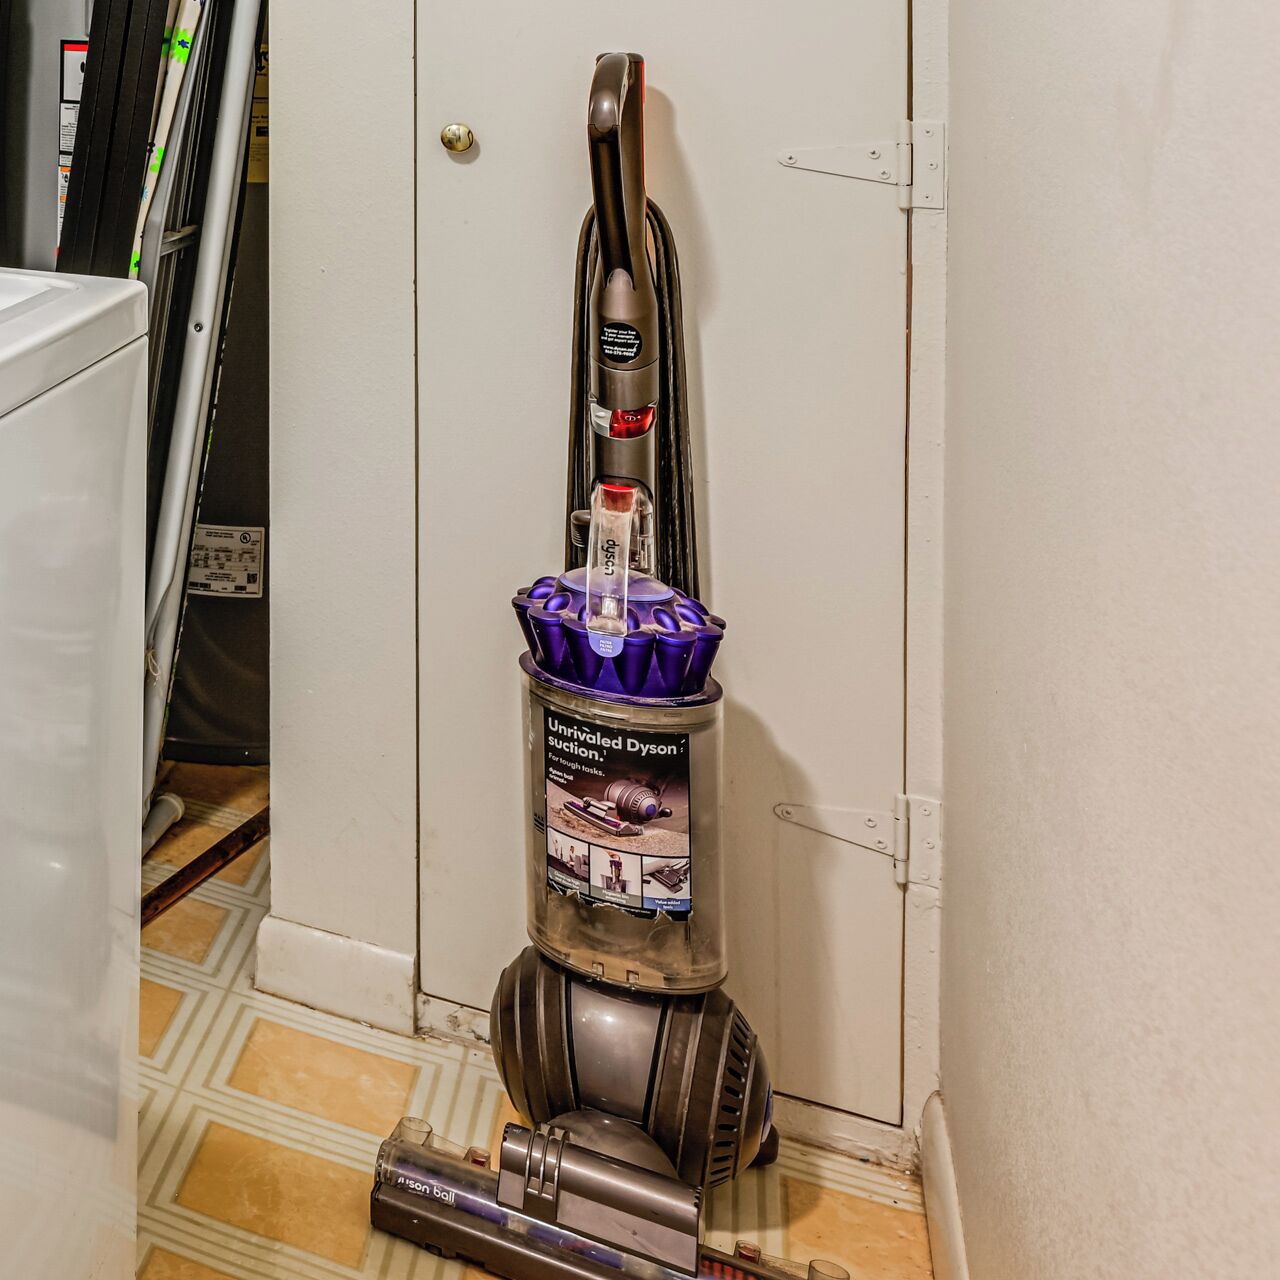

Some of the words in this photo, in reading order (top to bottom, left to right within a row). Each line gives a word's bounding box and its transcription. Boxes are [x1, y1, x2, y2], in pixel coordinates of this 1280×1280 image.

[601, 539, 620, 576] dyson
[548, 717, 622, 750] Unrivaled
[548, 752, 559, 762] For
[560, 756, 581, 770] tough
[582, 765, 605, 777] tasks.
[434, 1186, 455, 1203] ball
